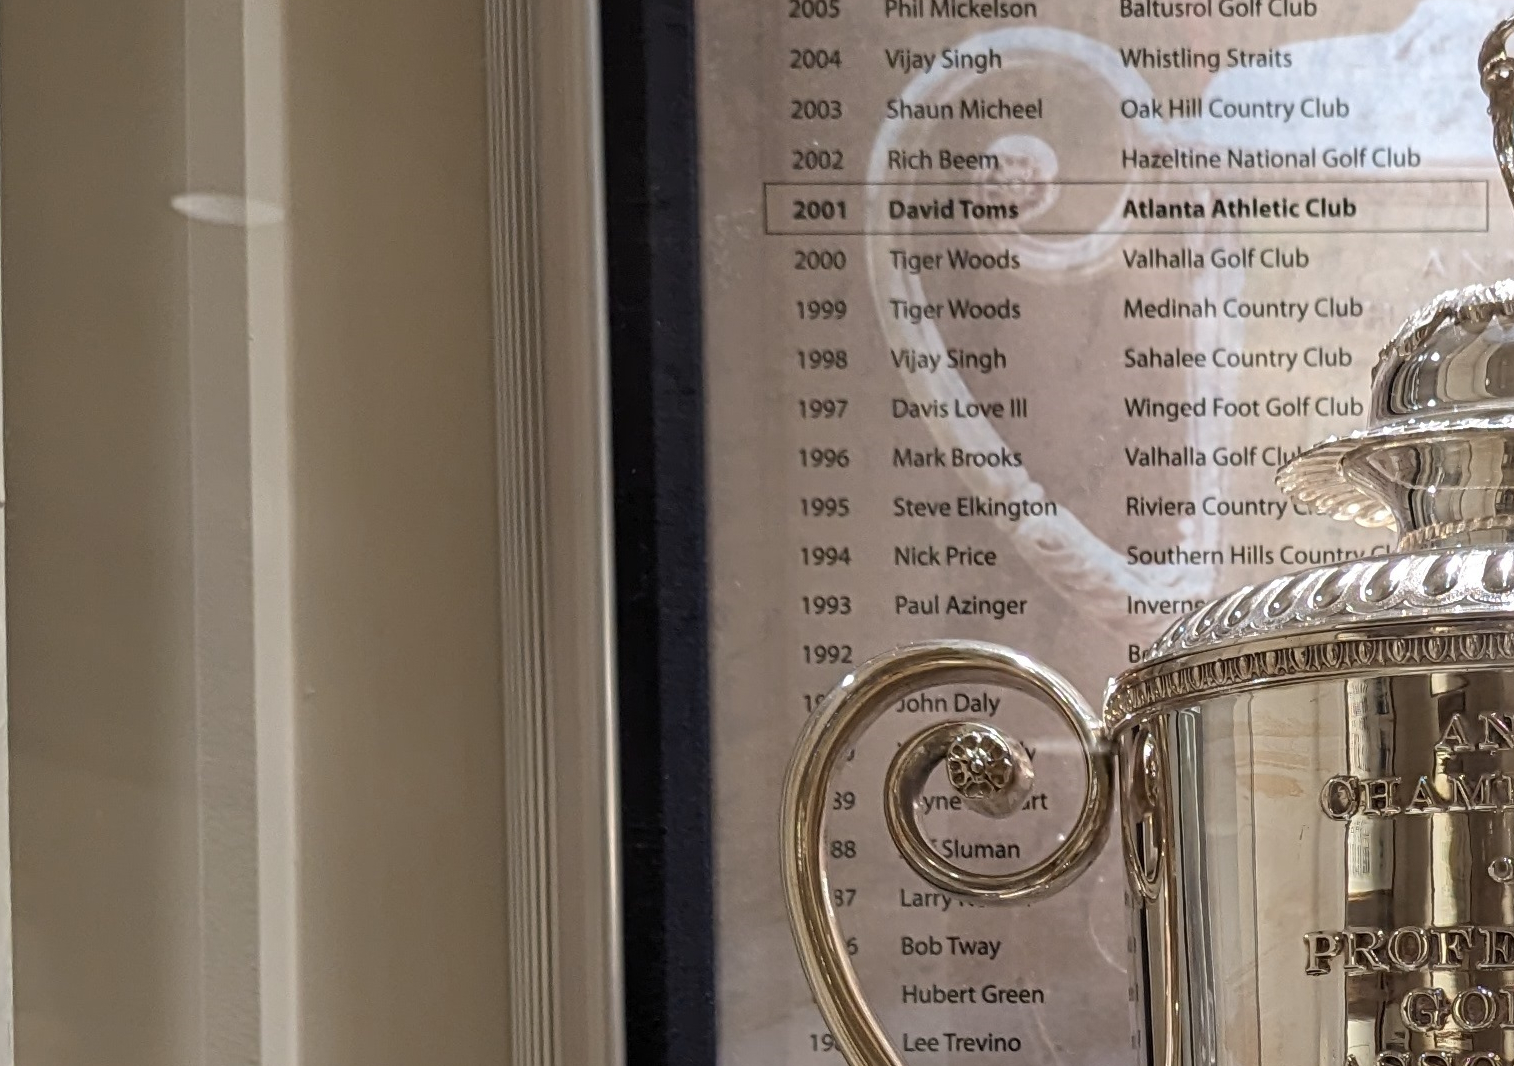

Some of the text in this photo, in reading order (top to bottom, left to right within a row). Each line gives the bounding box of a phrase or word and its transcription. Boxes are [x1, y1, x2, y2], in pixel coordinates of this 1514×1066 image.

[789, 47, 1293, 75] 2004 Vijay Singh Whistling Straits
[790, 96, 1350, 124] 2003 Shaun Micheel Oak Hill Country Club
[792, 146, 1422, 171] 2002 Rich Beem Hazeltine National Golf Club
[792, 196, 1357, 220] 2001 David Toms Atlanta Athletic Club
[794, 246, 1310, 275] 2000 Tiger Woods Valhalla Golf Club
[798, 395, 1364, 423] 1997 Davis Love III Winged Foot Golf Club
[902, 983, 1045, 1005] Hubert Green
